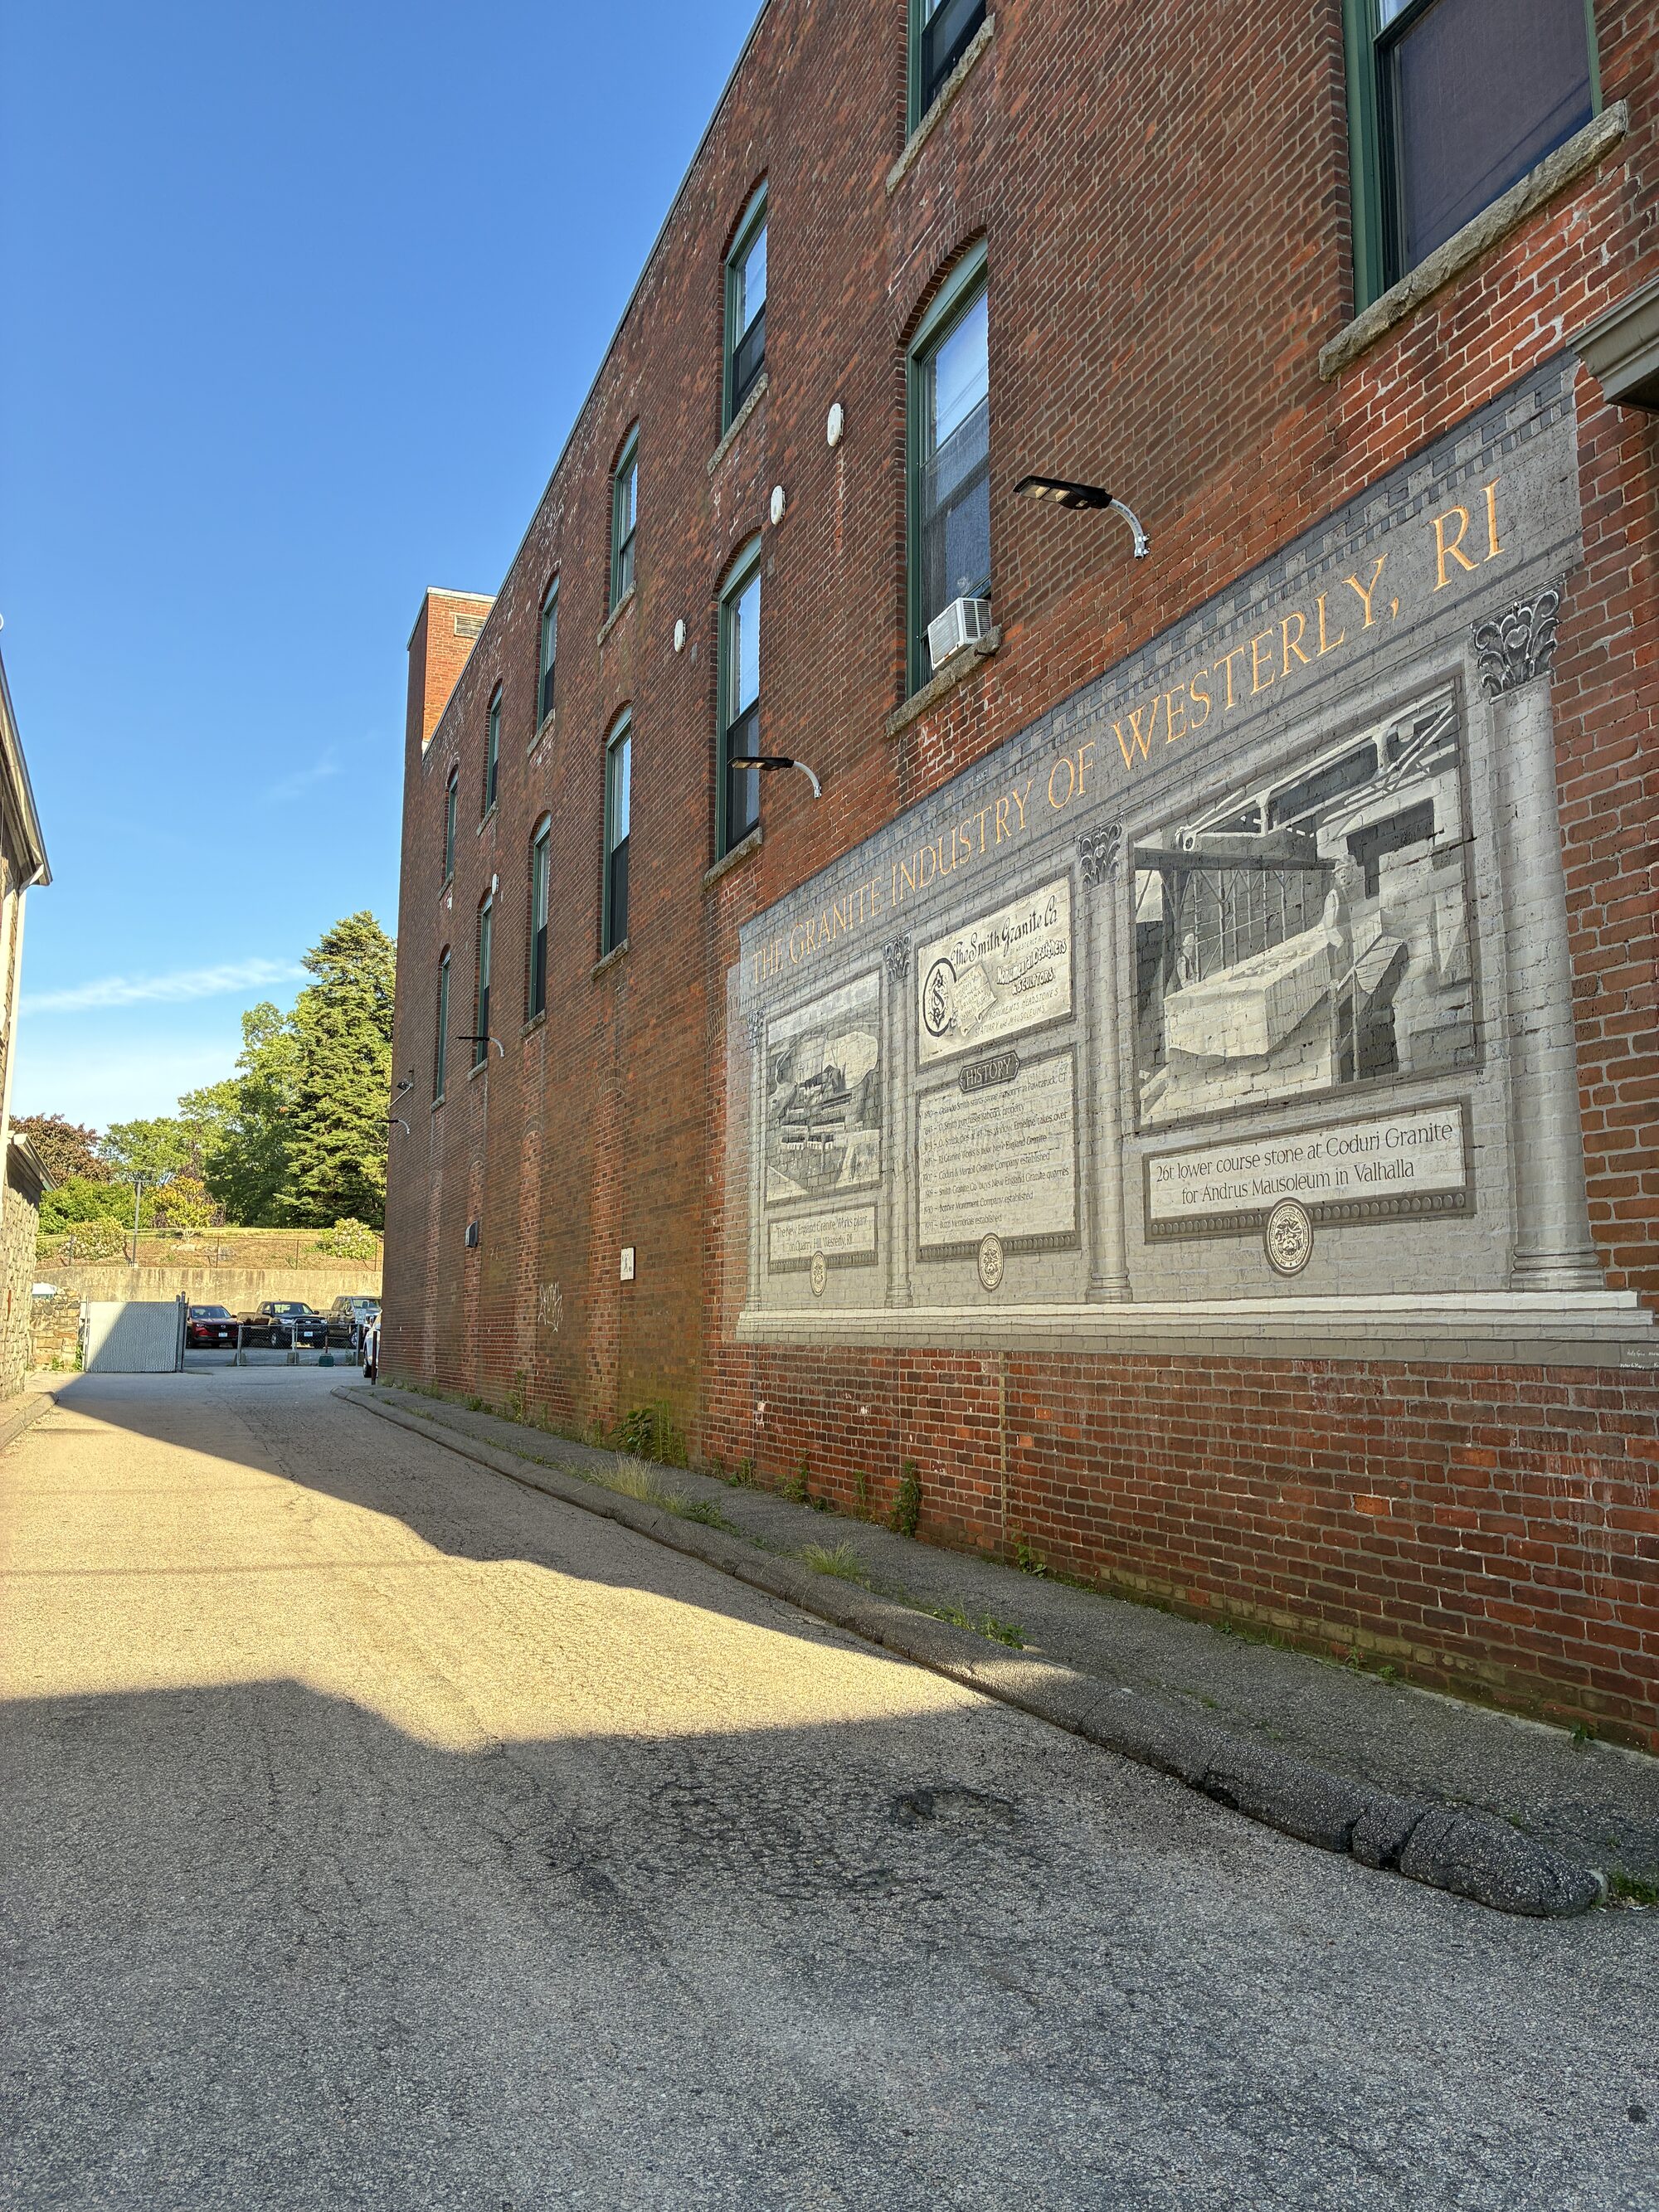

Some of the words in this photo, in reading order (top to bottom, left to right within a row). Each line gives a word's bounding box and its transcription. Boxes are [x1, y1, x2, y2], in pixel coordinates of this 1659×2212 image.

[752, 935, 784, 984] THE
[790, 876, 882, 965] GRANITE
[891, 777, 1035, 907] INDUSTRY
[1048, 742, 1095, 809] OF
[1112, 552, 1399, 771] WESTERLY,
[1429, 478, 1506, 592] RI
[951, 941, 968, 970] The
[968, 932, 1000, 962] Smith
[1001, 911, 1042, 958] Granite
[966, 1057, 1012, 1087] HISTORY
[1058, 1072, 1067, 1082] CT
[1038, 1115, 1052, 1124] takes
[1053, 1111, 1067, 1121] over
[1005, 1138, 1025, 1150] England
[1026, 1133, 1047, 1144] Granite
[1155, 1165, 1175, 1182] 26t
[1178, 1160, 1213, 1179] lower
[1216, 1154, 1260, 1174] course
[1264, 1147, 1303, 1167] stone
[1307, 1143, 1323, 1159] at
[1326, 1131, 1380, 1158] Coduri
[1385, 1121, 1453, 1149] Granite
[938, 1169, 953, 1179] Coduri
[976, 1161, 994, 1172] Granite
[995, 1156, 1019, 1170] Company
[1019, 1150, 1049, 1164] established
[952, 1183, 969, 1193] Granite
[991, 1178, 1003, 1186] New
[1005, 1174, 1024, 1185] England
[1025, 1169, 1045, 1180] Granite
[1181, 1187, 1199, 1205] for
[1202, 1181, 1248, 1203] Andrus
[1252, 1170, 1331, 1196] Mausoleum
[1335, 1168, 1350, 1185] in
[1354, 1159, 1415, 1184] Valhalla
[980, 1195, 1003, 1208] Company
[1004, 1191, 1033, 1202] established
[798, 1223, 815, 1235] England
[816, 1219, 835, 1231] Granite
[975, 1213, 1002, 1223] established
[795, 1240, 811, 1252] Quarry
